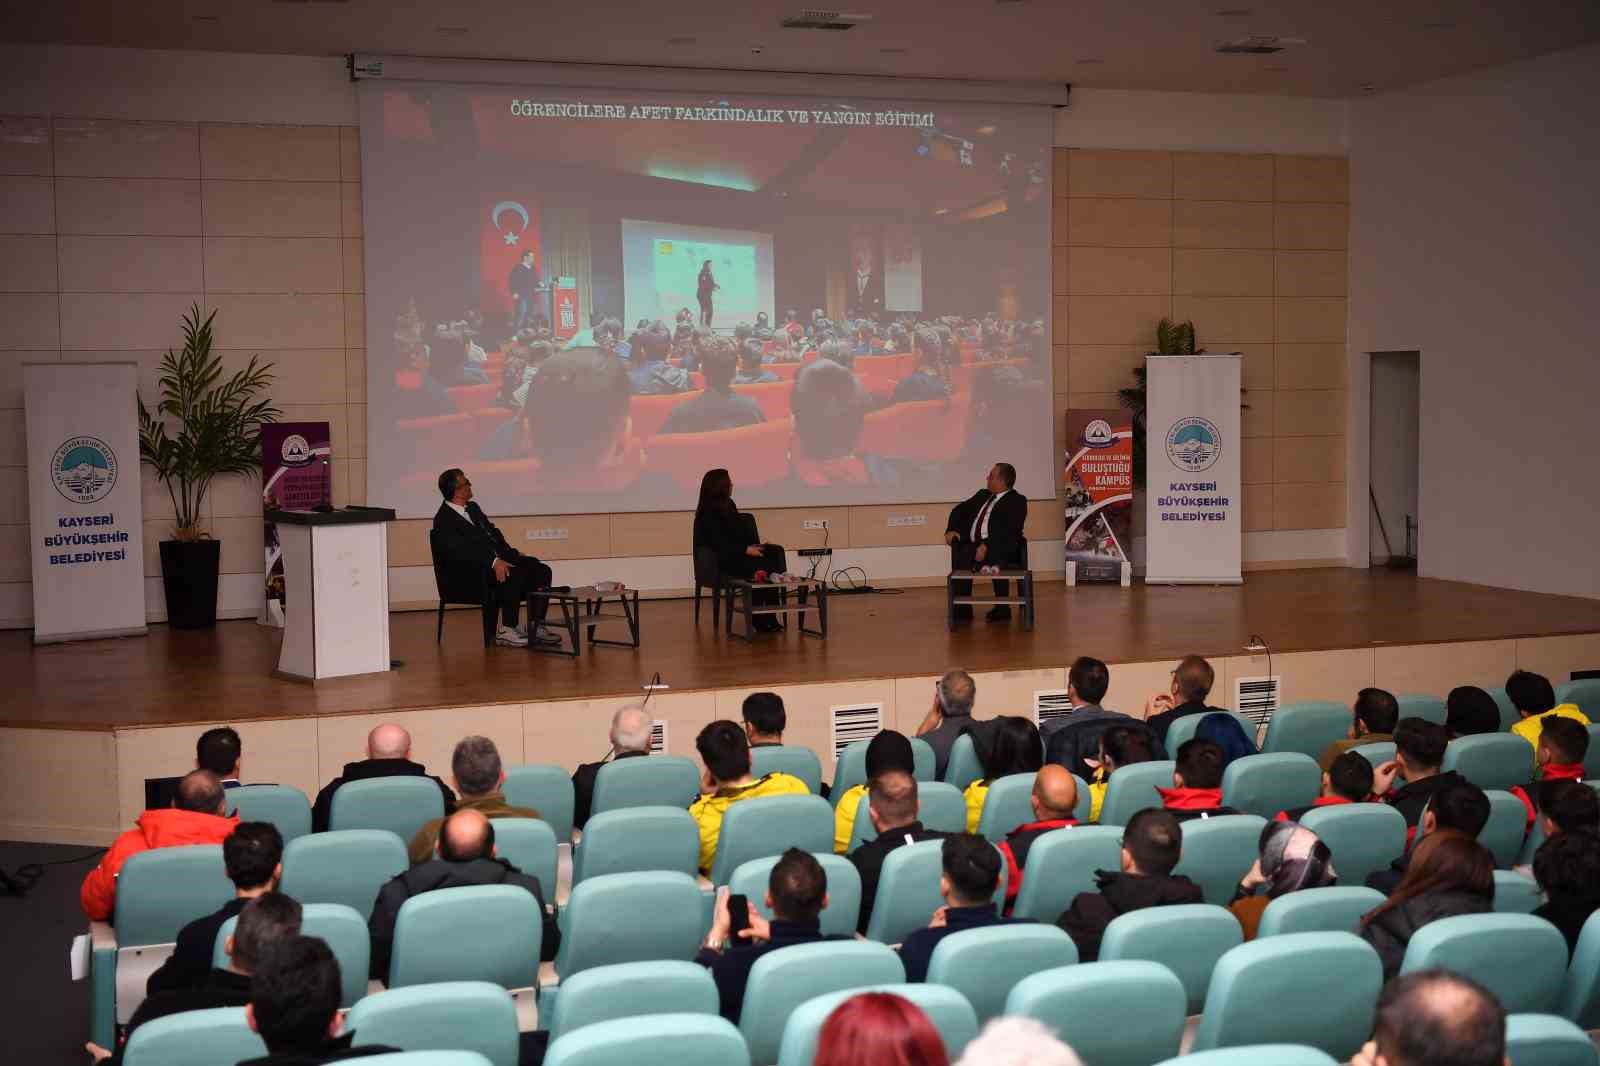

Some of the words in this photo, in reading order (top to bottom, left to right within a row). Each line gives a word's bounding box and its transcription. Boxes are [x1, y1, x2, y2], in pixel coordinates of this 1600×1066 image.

[510, 98, 626, 119] ÖĞRENCİLERE
[629, 104, 671, 120] AFET
[675, 105, 784, 123] FARKINDALIK
[786, 110, 809, 123] VE
[812, 110, 872, 126] YANGIN
[875, 108, 935, 127] EĞİTİMİ
[1081, 462, 1130, 475] BULUŞTUĞU
[1095, 473, 1130, 486] KAMPÜS
[1169, 480, 1217, 492] KAYSERİ
[1157, 496, 1230, 508] BÜYÜKŞEHİR
[58, 512, 113, 528] KAYSERİ
[1161, 511, 1226, 521] BELEDİYESİ
[44, 531, 129, 547] BÜYÜKŞEHİR
[49, 548, 126, 565] BELEDİYESİ
